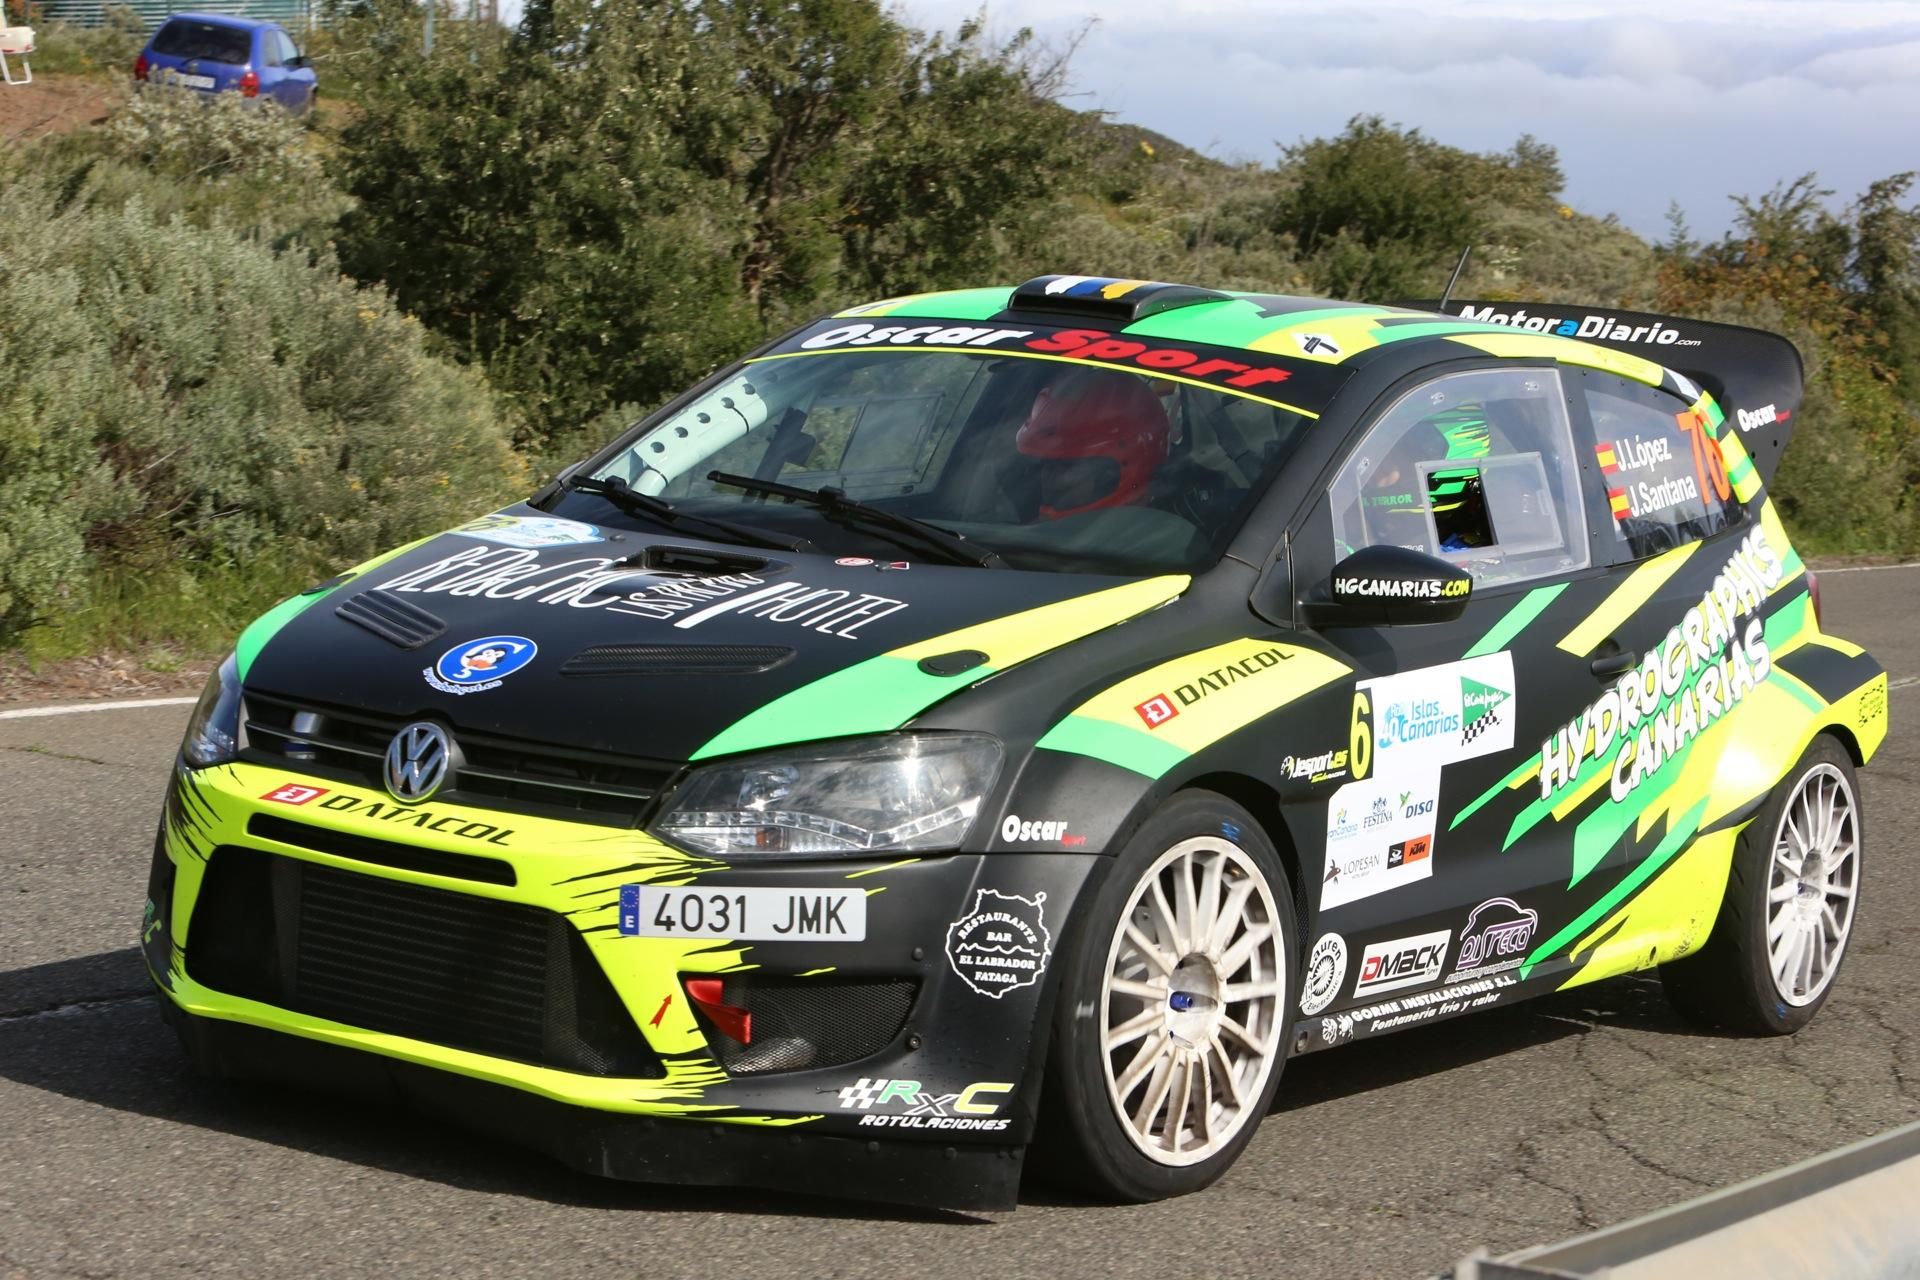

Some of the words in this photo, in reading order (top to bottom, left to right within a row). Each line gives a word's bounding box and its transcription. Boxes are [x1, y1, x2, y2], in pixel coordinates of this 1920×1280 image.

[800, 323, 1034, 350] Oscar
[1024, 329, 1293, 389] Sport
[1737, 404, 1776, 432] Oscar
[1334, 578, 1470, 598] HGCANARIAS.COM
[737, 586, 910, 640] HOTEL
[1540, 522, 1784, 801] HYDROGRAPHICS
[1174, 648, 1295, 706] DATACOL
[1411, 699, 1440, 721] Islas
[1611, 618, 1771, 803] CANARIAS
[1350, 692, 1371, 780] 6
[1400, 714, 1459, 742] Canarias
[318, 794, 516, 846] DATACOL
[1002, 814, 1068, 843] Oscar
[1363, 811, 1393, 829] FESTINA
[1409, 842, 1427, 857] KTM
[1343, 855, 1380, 875] LOPESAN
[653, 893, 747, 933] 4031
[772, 895, 848, 934] JMK
[958, 912, 1038, 944] RESTAURANTE
[986, 931, 1013, 943] BAR
[959, 955, 974, 965] EL
[975, 956, 1036, 970] LABRADOR
[974, 971, 1018, 984] FATAGA
[1399, 980, 1495, 1010] INSTALACIONES
[1461, 999, 1471, 1012] y
[858, 1114, 1012, 1130] ROTULACIONES
